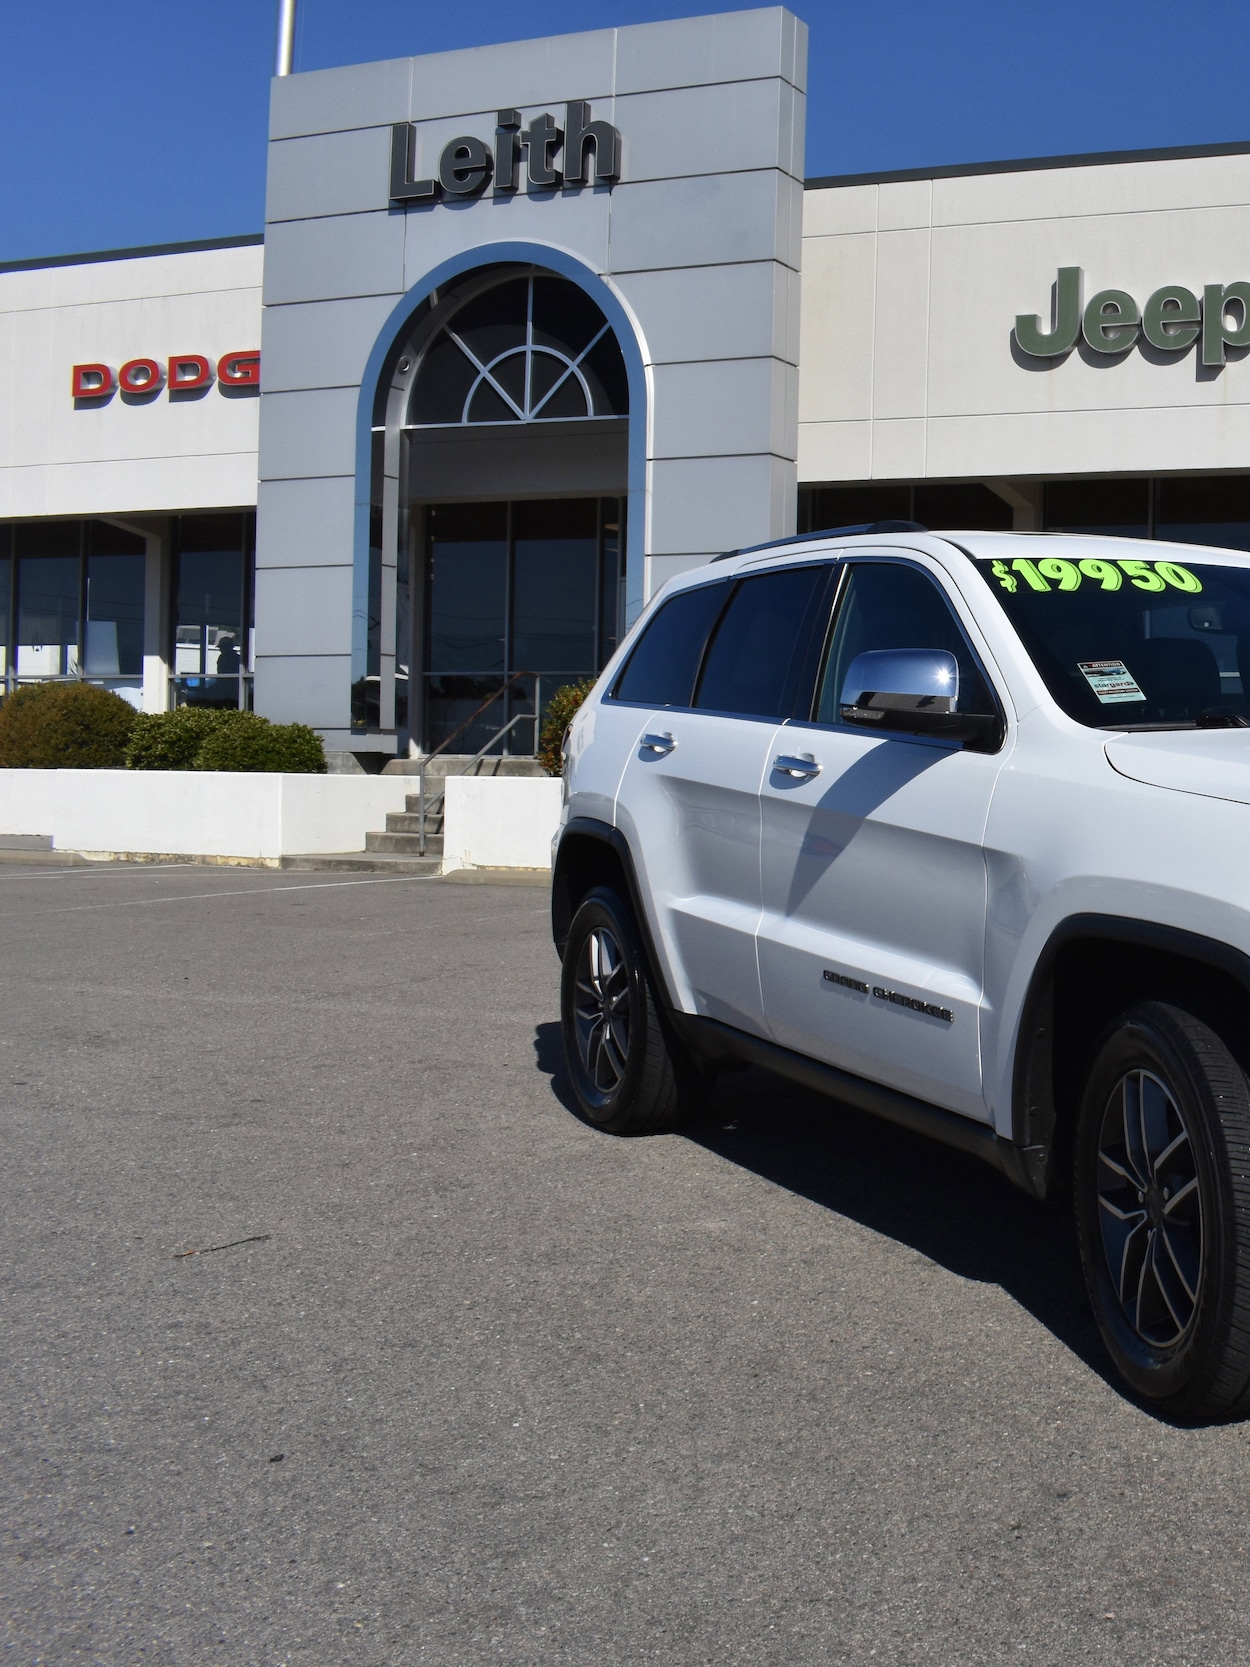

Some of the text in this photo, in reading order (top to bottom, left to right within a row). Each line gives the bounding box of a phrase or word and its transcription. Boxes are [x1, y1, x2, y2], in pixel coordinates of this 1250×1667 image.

[388, 100, 621, 200] Leith
[72, 350, 261, 397] DODG
[992, 558, 1203, 593] $19950
